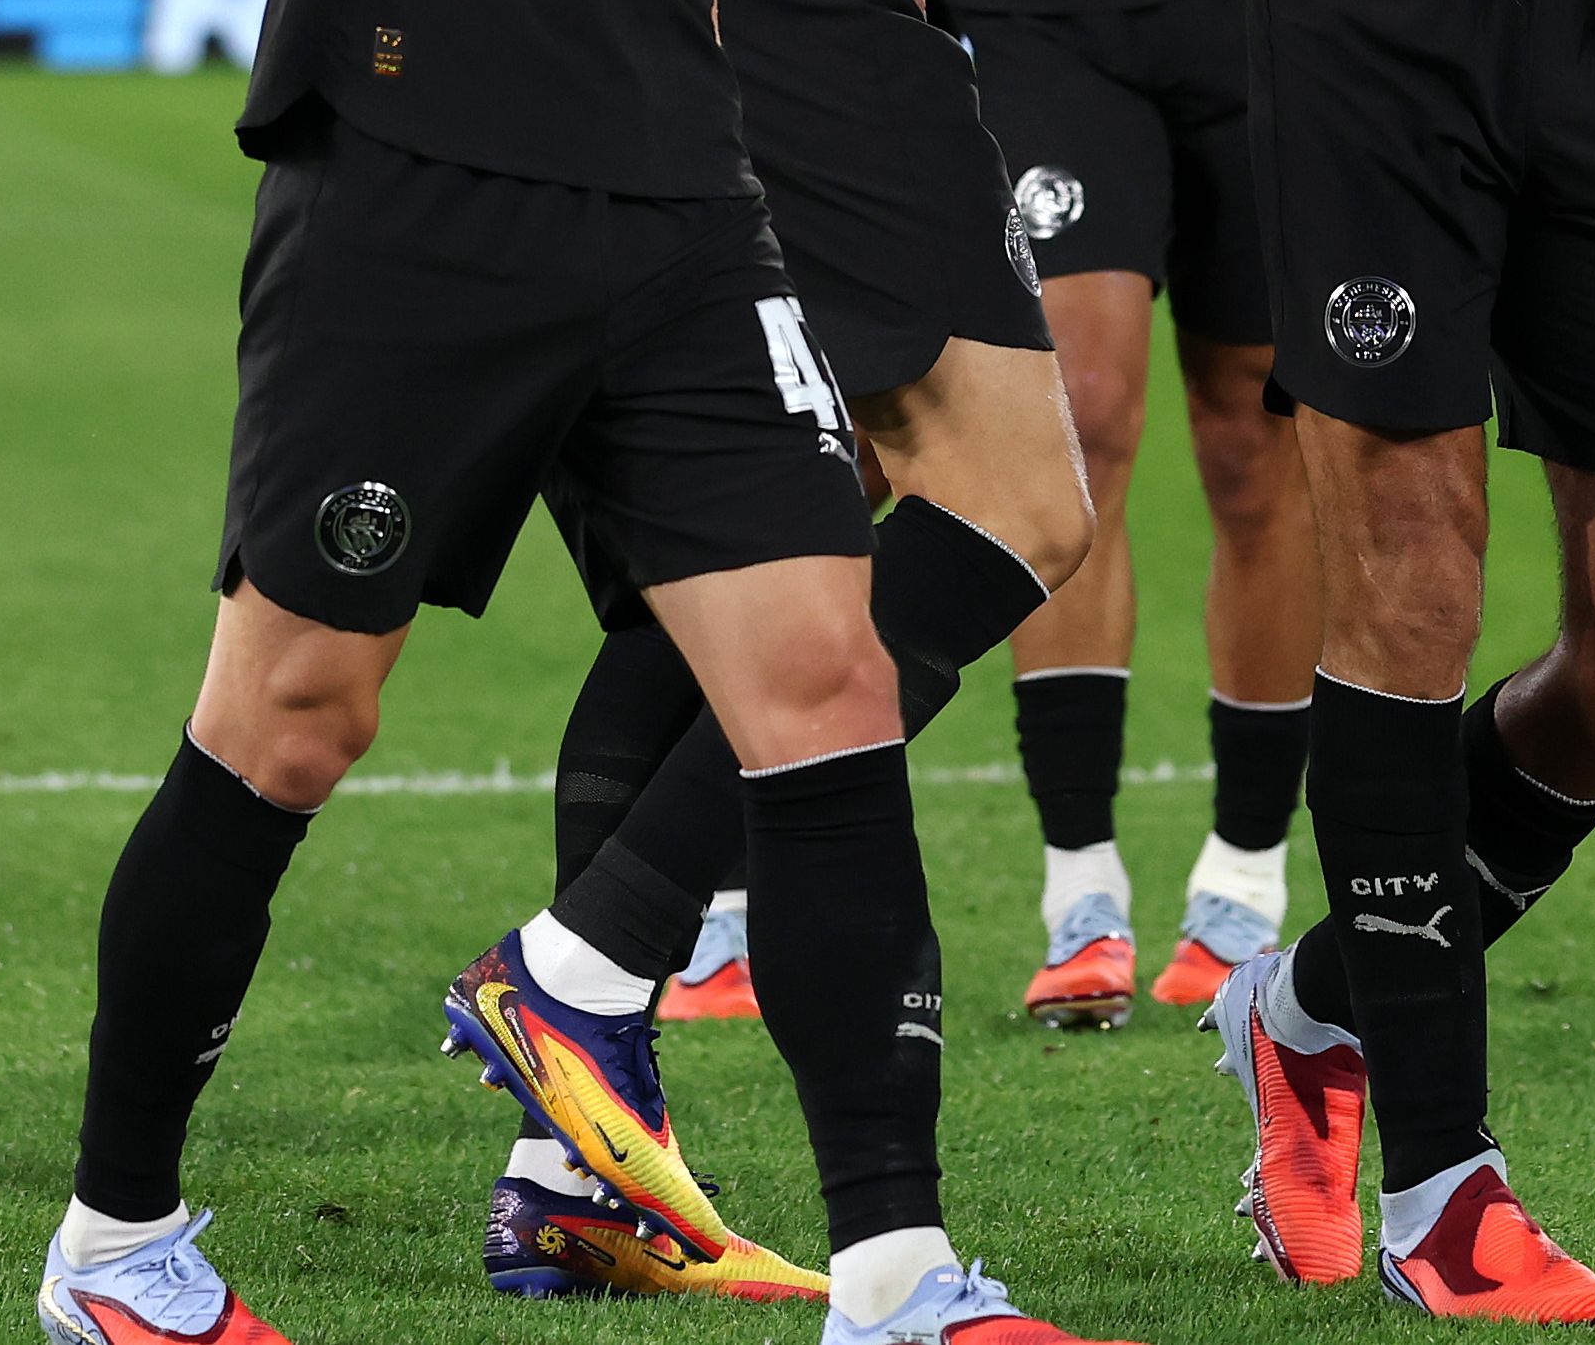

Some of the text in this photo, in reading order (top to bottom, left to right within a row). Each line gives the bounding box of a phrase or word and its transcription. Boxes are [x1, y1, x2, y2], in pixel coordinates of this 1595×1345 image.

[755, 296, 855, 432] 4
[1351, 872, 1439, 896] CITY
[903, 992, 943, 1011] CIT
